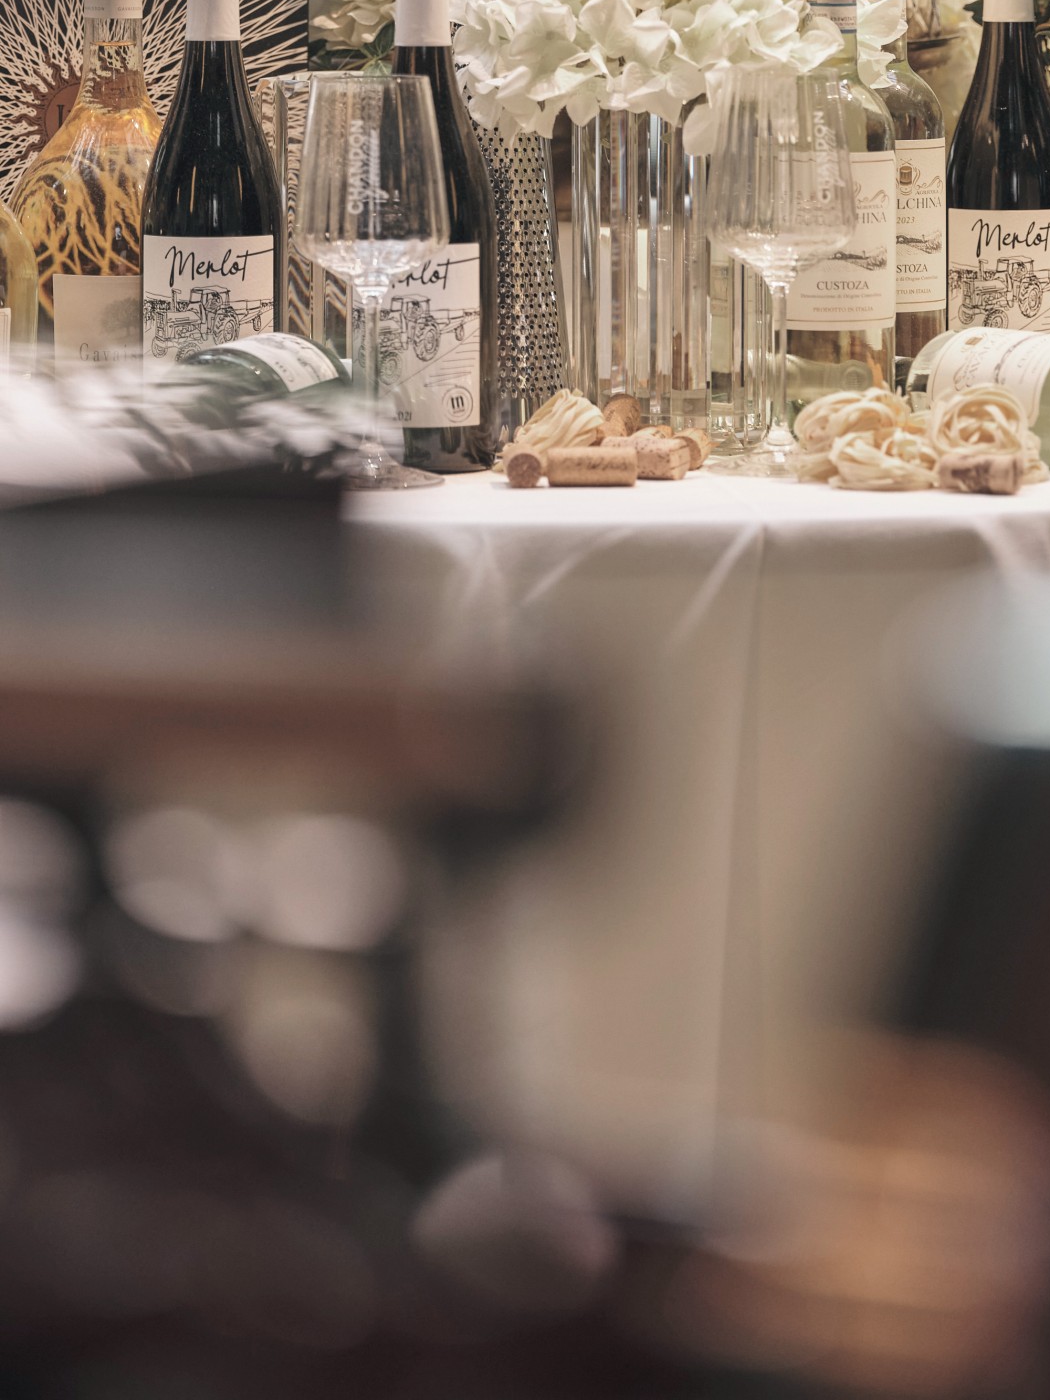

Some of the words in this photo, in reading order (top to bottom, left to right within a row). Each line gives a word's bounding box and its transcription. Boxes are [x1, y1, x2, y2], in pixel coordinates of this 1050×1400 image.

[347, 120, 364, 214] CHANDON
[896, 197, 942, 210] LCHINA
[165, 245, 274, 288] Merlot
[391, 257, 480, 290] rlot
[896, 264, 928, 274] STOZA
[816, 280, 870, 291] CUSTOZA
